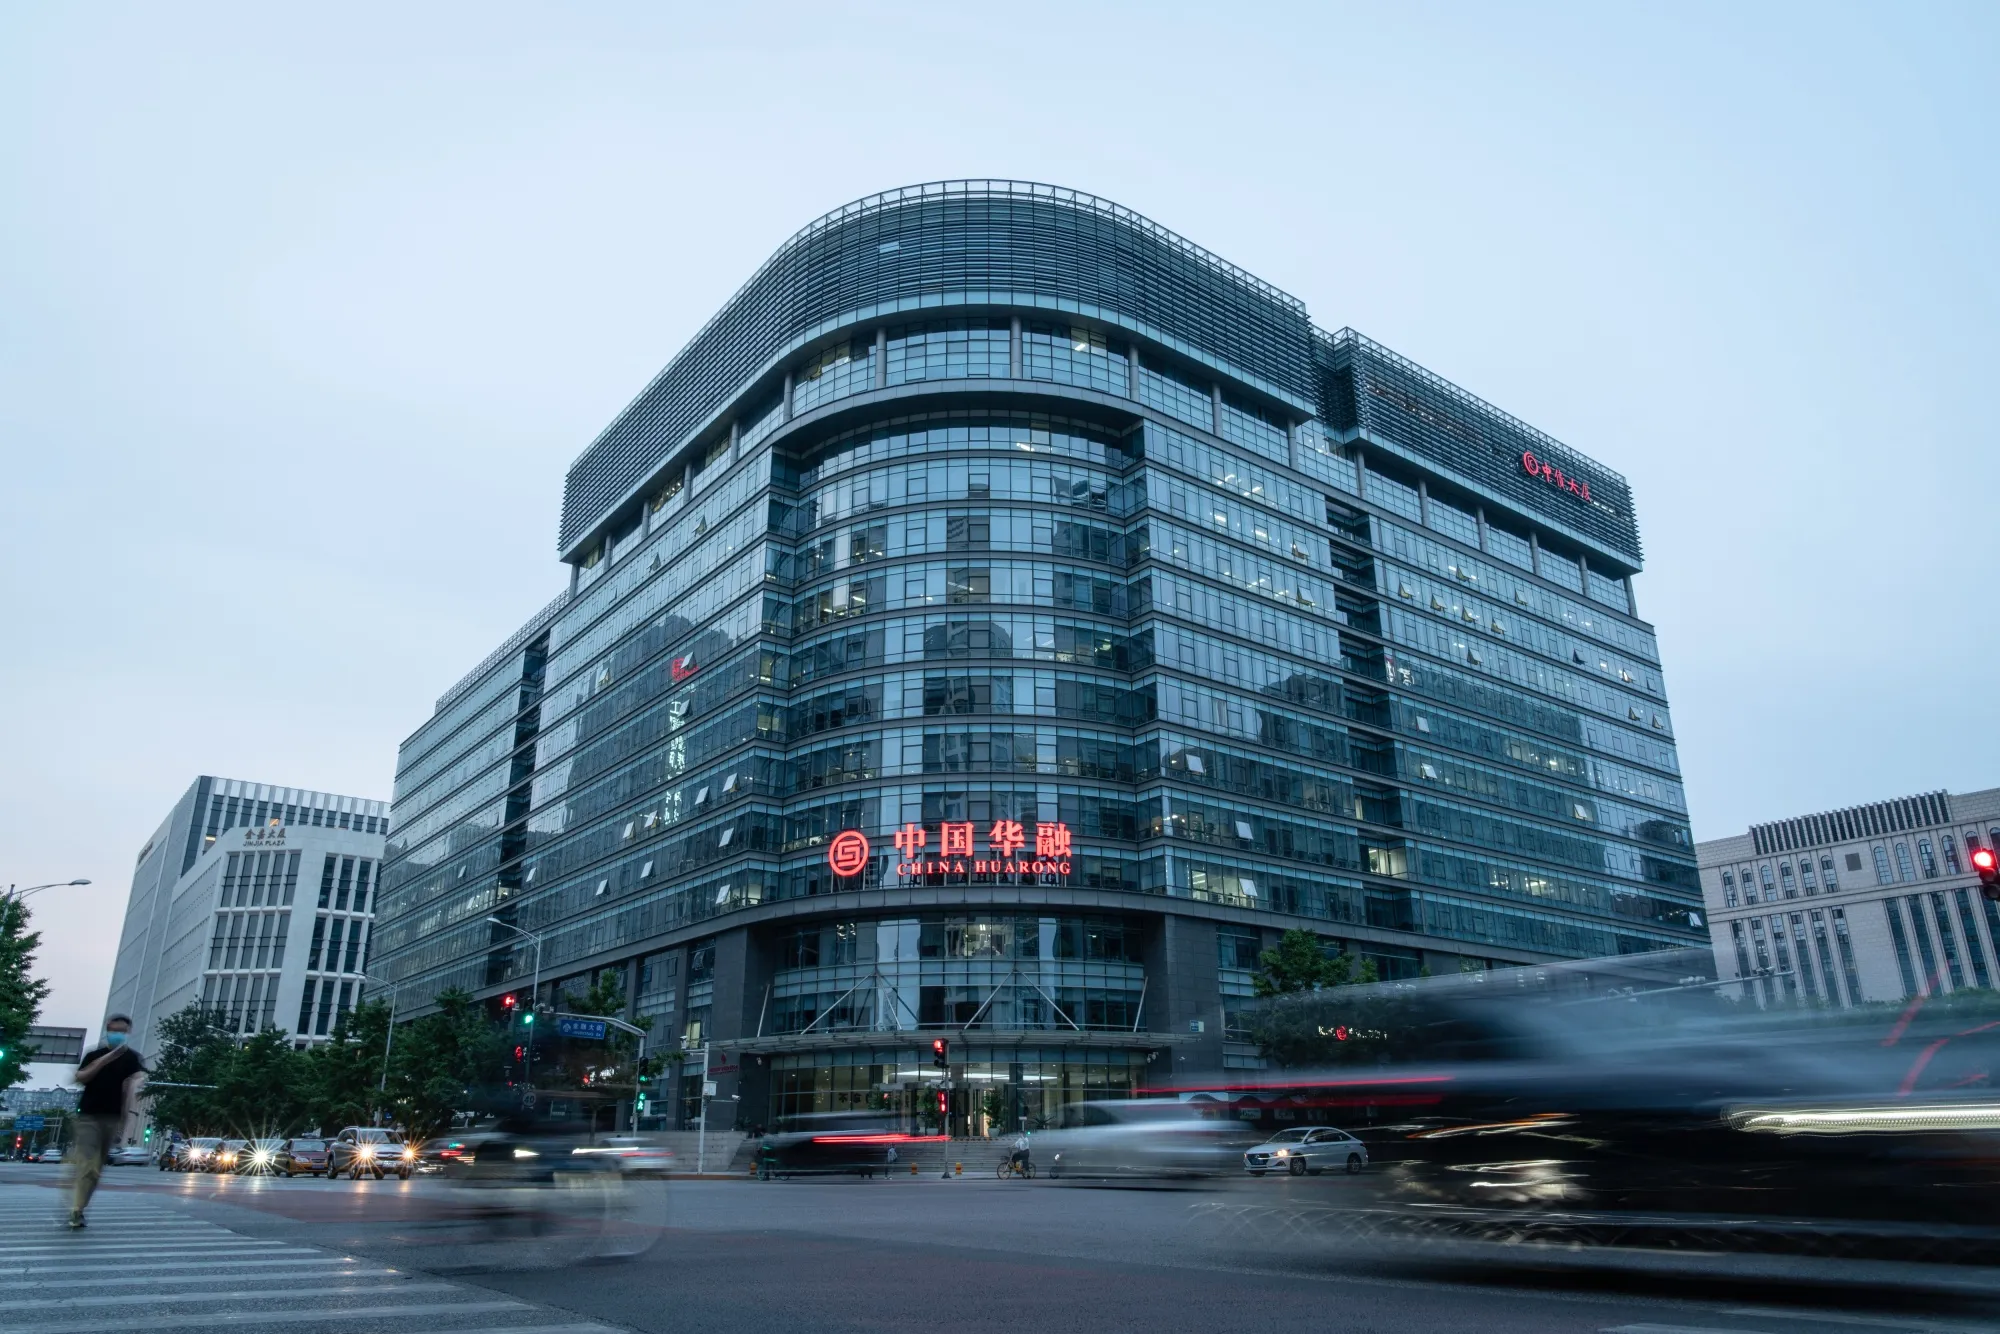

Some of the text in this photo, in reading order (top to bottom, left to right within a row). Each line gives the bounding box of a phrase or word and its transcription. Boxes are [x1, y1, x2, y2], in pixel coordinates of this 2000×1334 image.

[895, 820, 1072, 859] 中国华融
[897, 860, 1071, 875] CHINA HUARONG
[524, 1095, 535, 1104] 40
